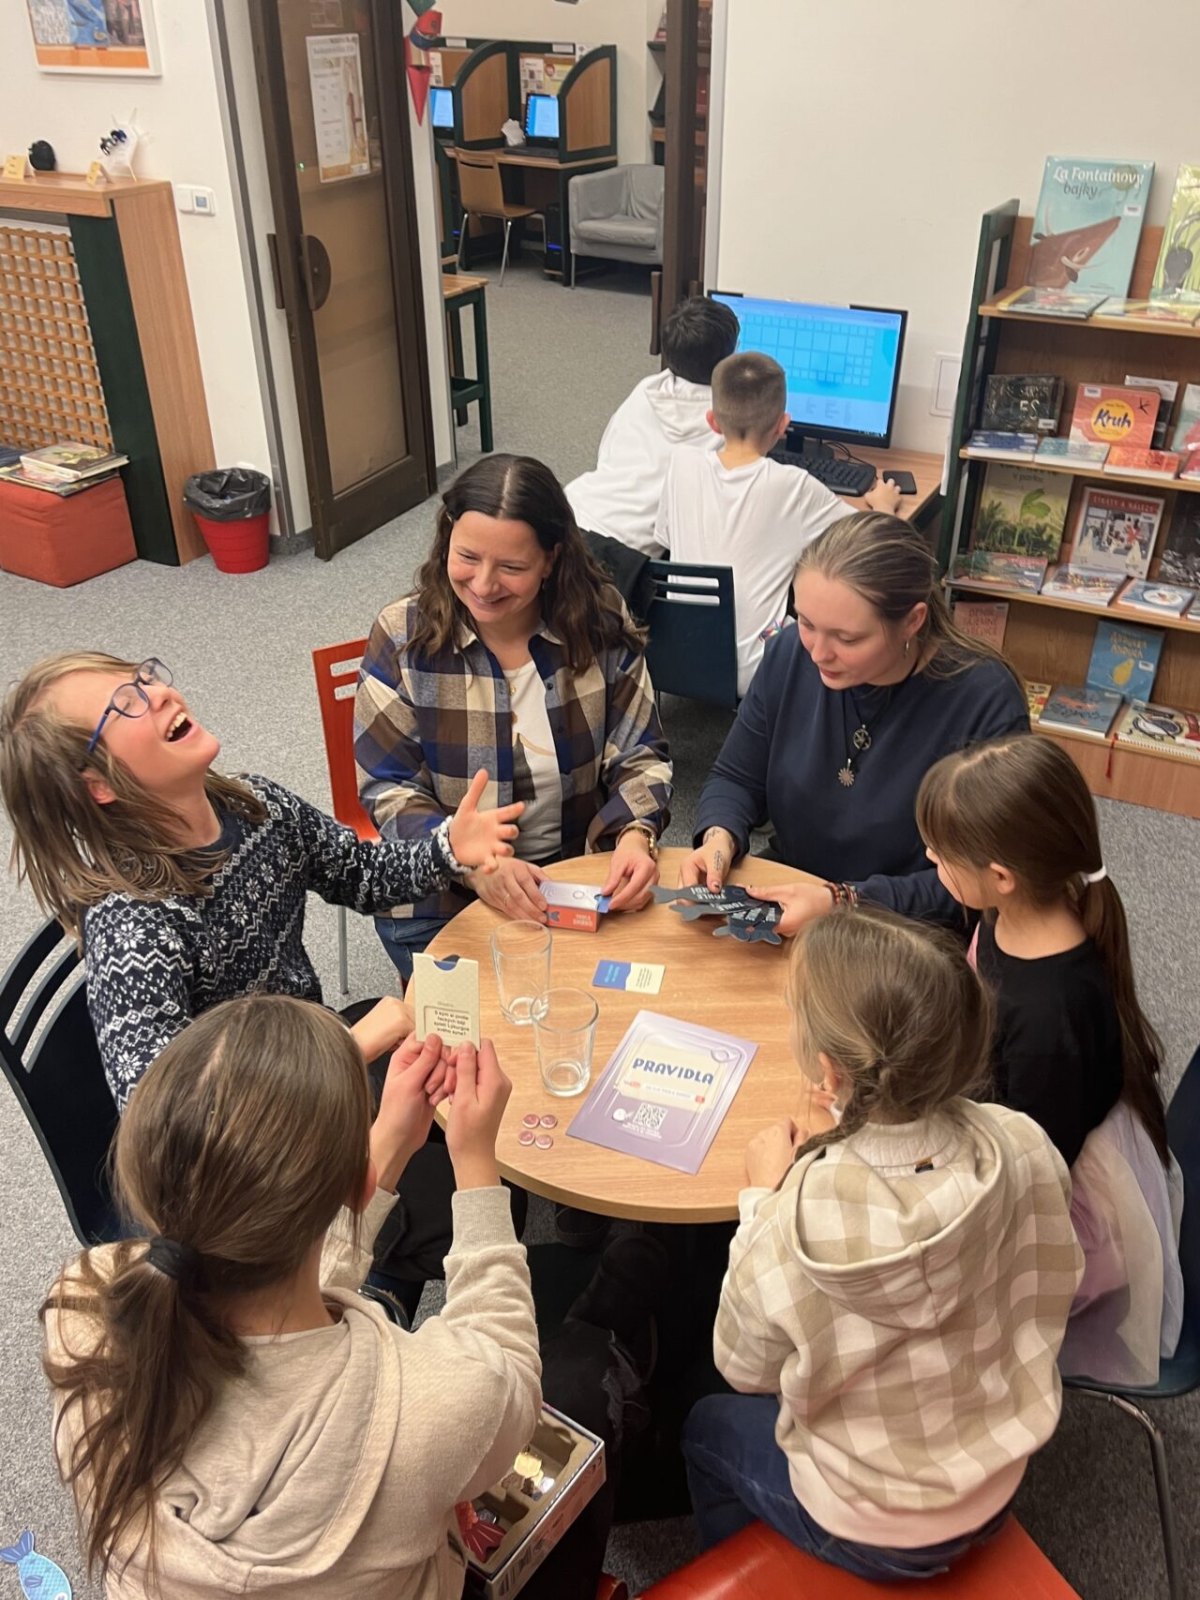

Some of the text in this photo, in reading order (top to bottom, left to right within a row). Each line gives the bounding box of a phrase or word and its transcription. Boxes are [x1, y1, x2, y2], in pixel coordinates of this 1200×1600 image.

[1053, 166, 1144, 188] La Fontainovy
[1064, 182, 1098, 200] bajky
[1094, 408, 1131, 428] Kruh
[632, 1057, 714, 1085] PRAVIDLA
